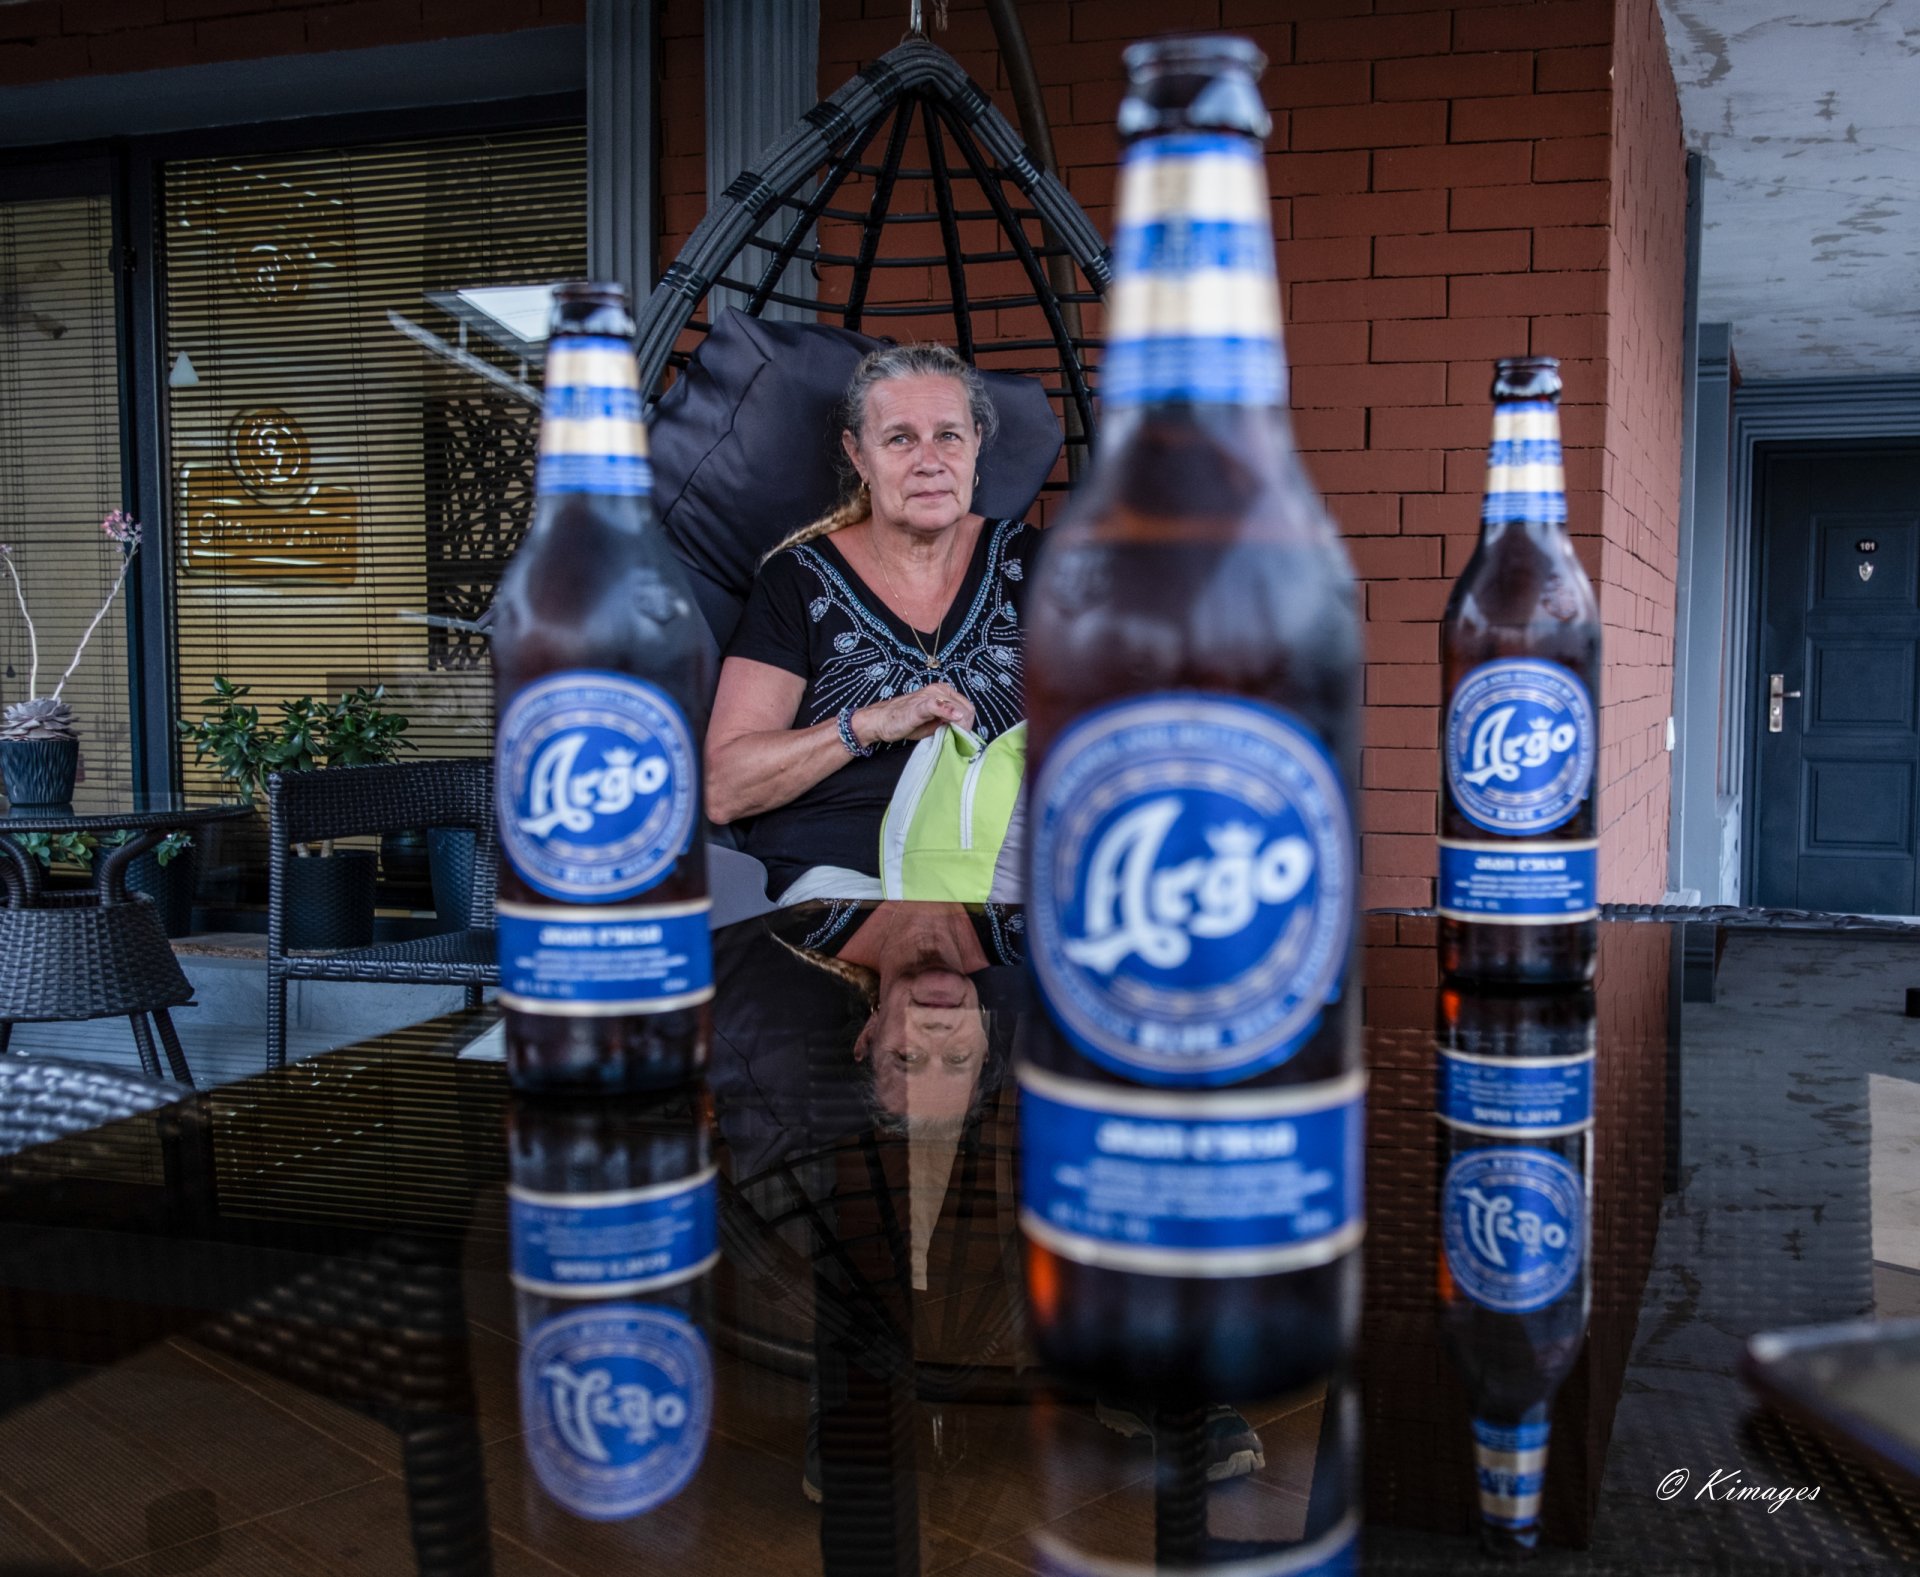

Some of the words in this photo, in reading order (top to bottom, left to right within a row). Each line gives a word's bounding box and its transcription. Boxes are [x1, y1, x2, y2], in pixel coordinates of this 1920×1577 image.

[1860, 542, 1876, 551] 101
[518, 731, 670, 839] Argo
[1462, 705, 1577, 787] Argo
[1063, 796, 1315, 976] Argo
